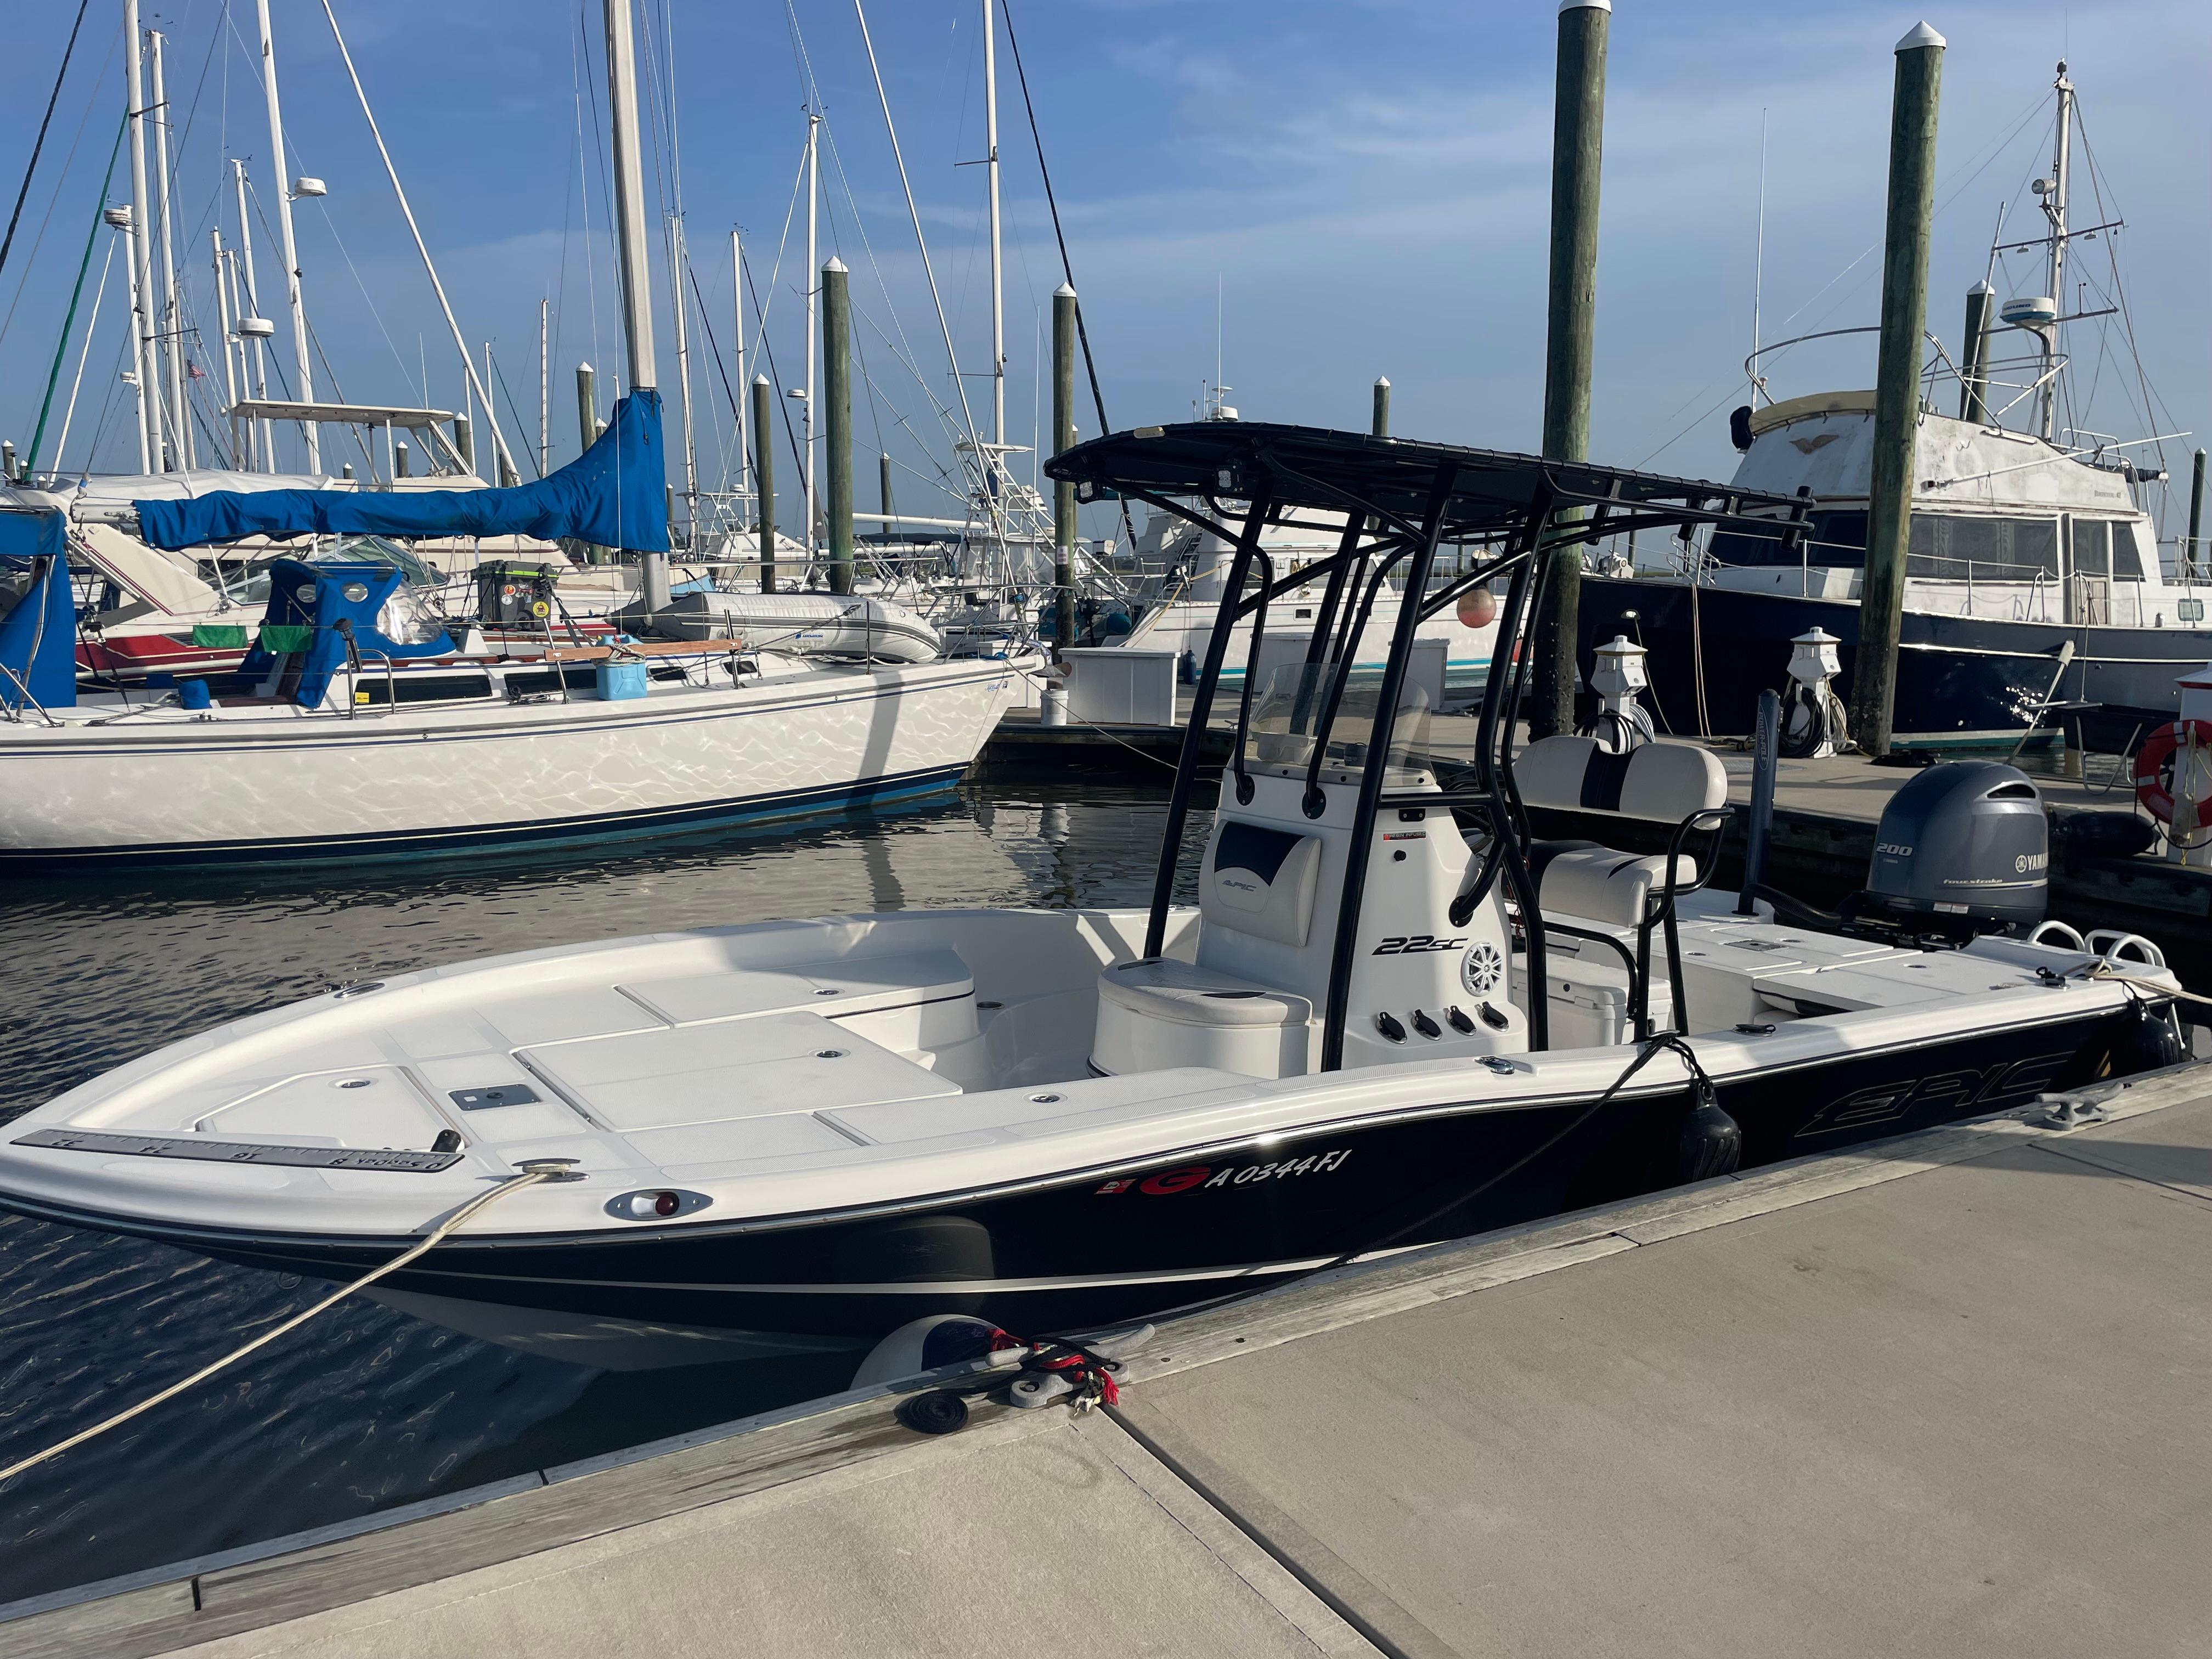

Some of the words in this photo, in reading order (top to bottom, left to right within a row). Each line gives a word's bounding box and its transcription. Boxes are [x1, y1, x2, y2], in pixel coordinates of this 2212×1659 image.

[1876, 843, 1913, 856] 200
[52, 1139, 83, 1147] 32
[139, 1146, 173, 1154] 24
[230, 1152, 262, 1160] 16
[356, 1158, 422, 1169] SeaDek
